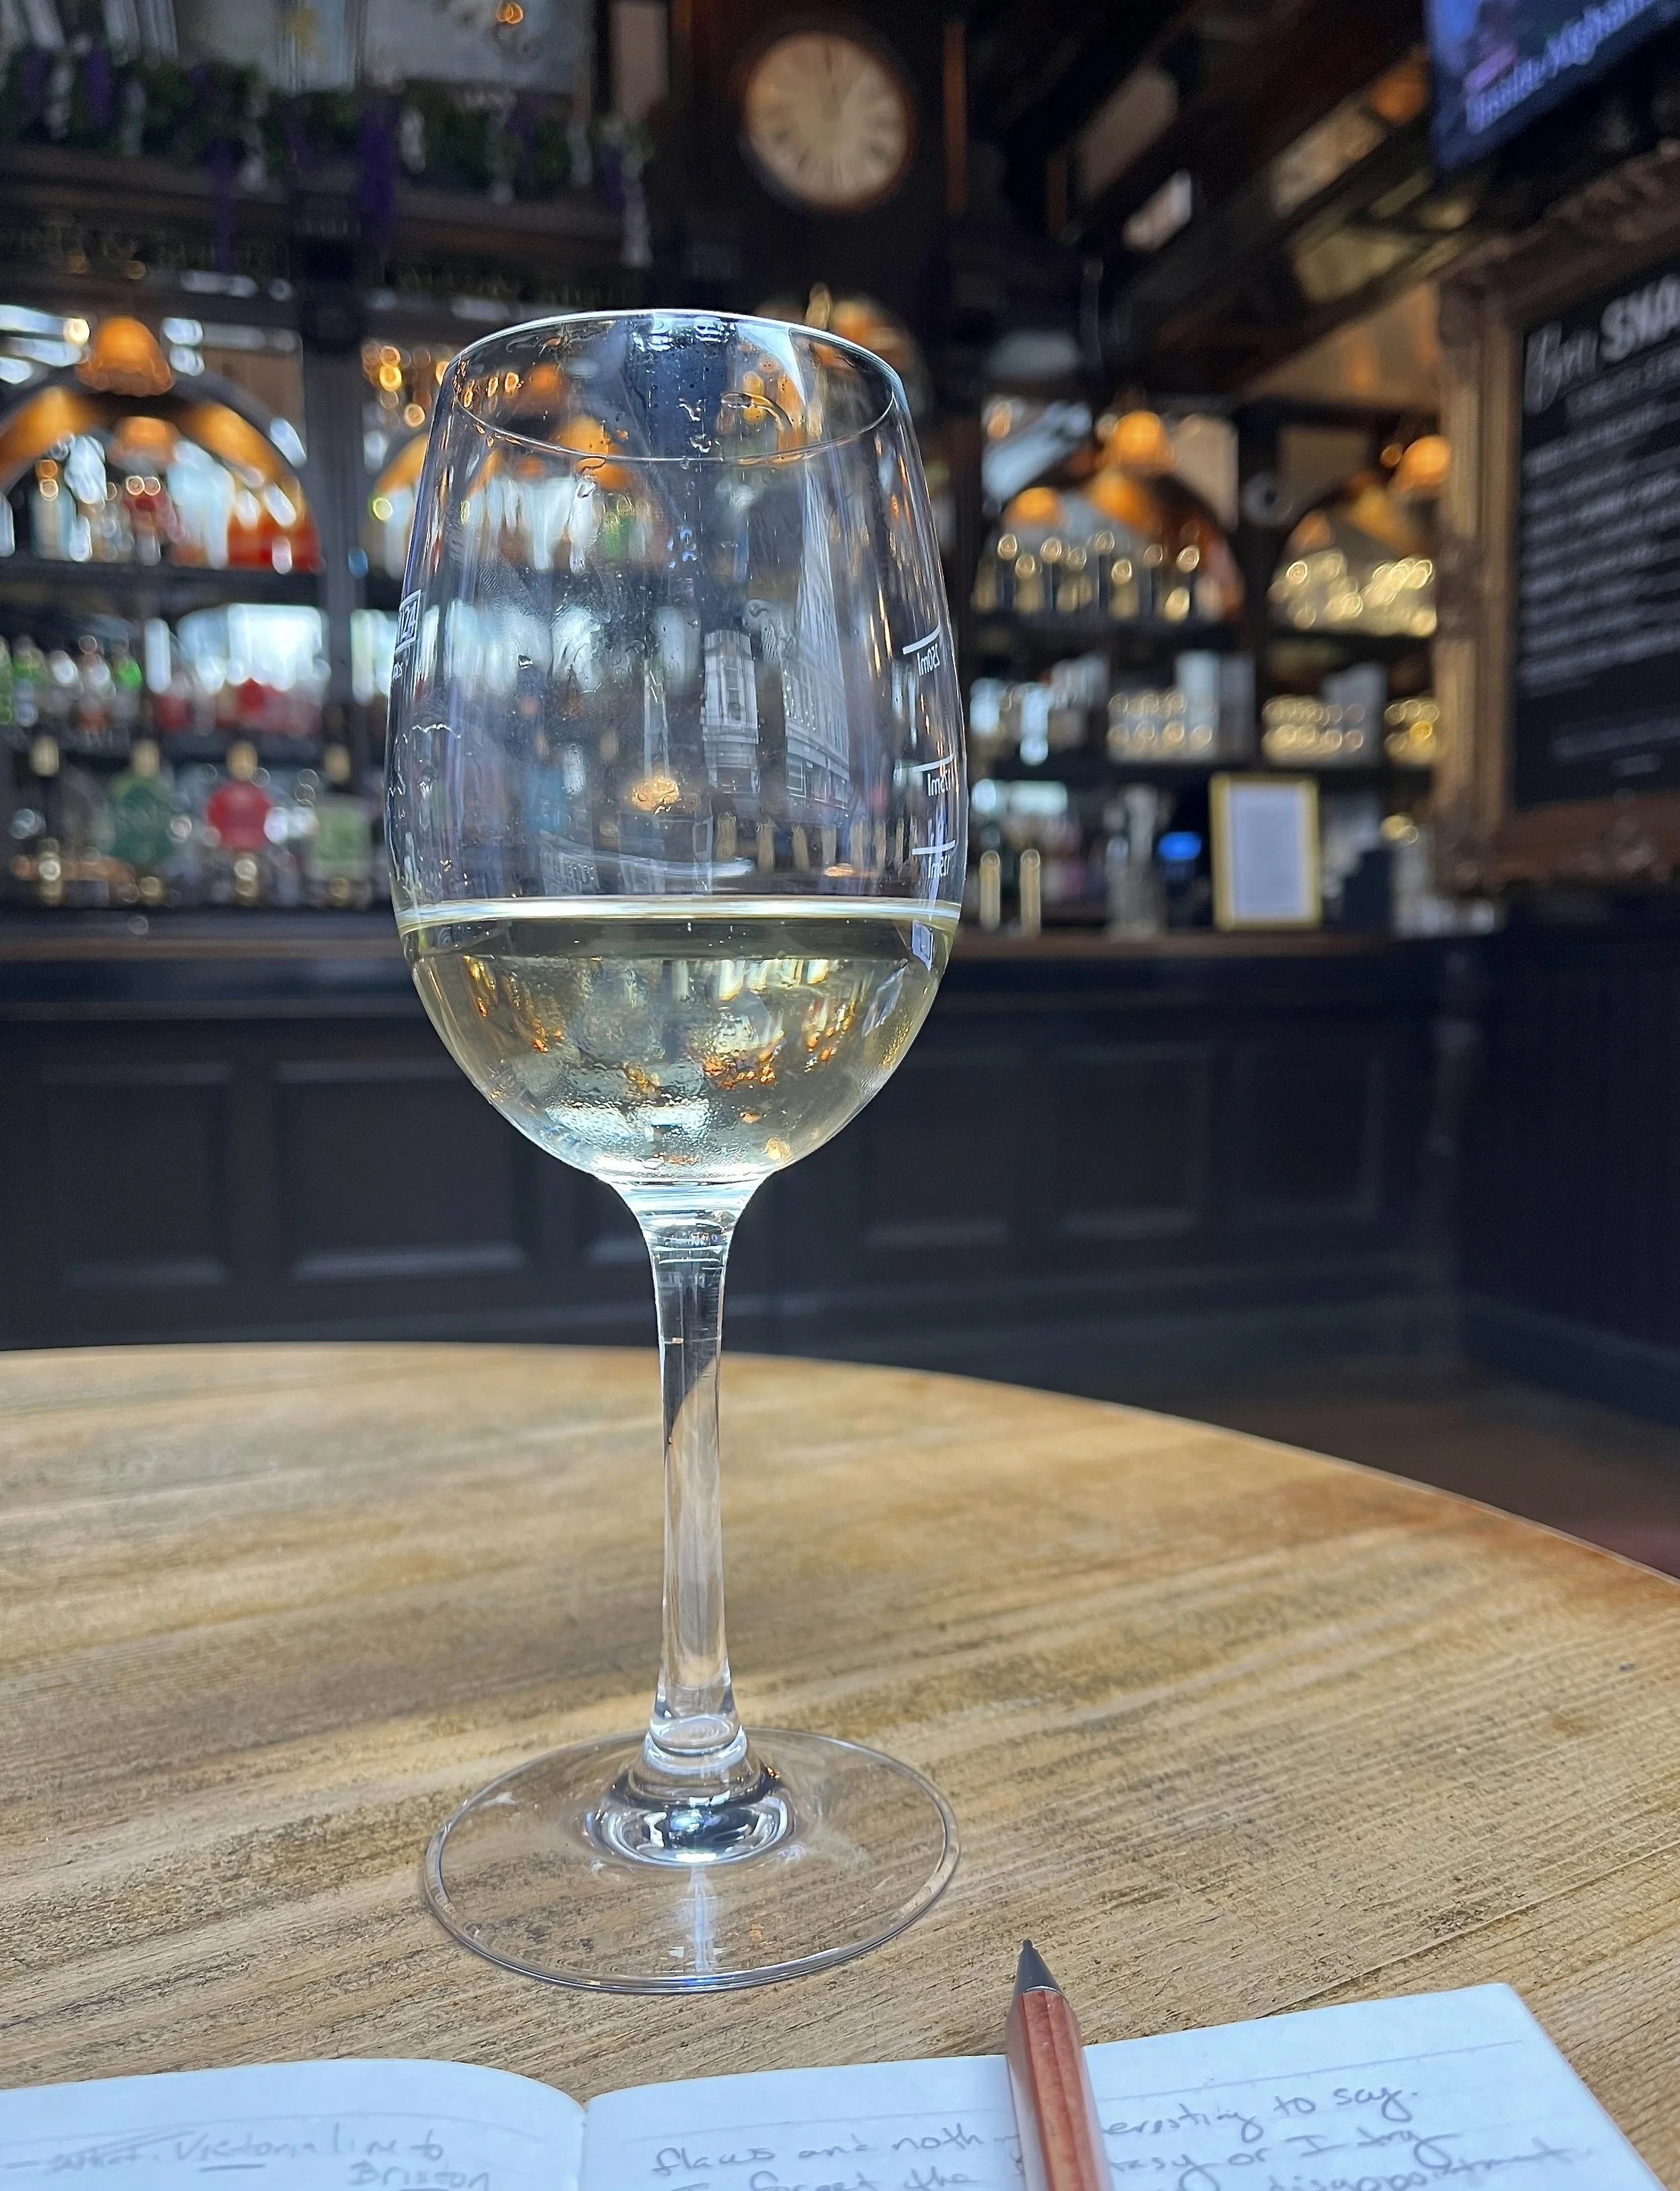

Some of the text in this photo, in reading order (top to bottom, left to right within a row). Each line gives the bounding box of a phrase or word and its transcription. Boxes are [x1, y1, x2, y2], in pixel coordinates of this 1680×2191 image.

[1101, 2103, 1264, 2144] eresting
[1273, 2096, 1316, 2116] to
[407, 2128, 444, 2161] to
[1227, 2147, 1270, 2166] or
[1282, 2134, 1347, 2157] I
